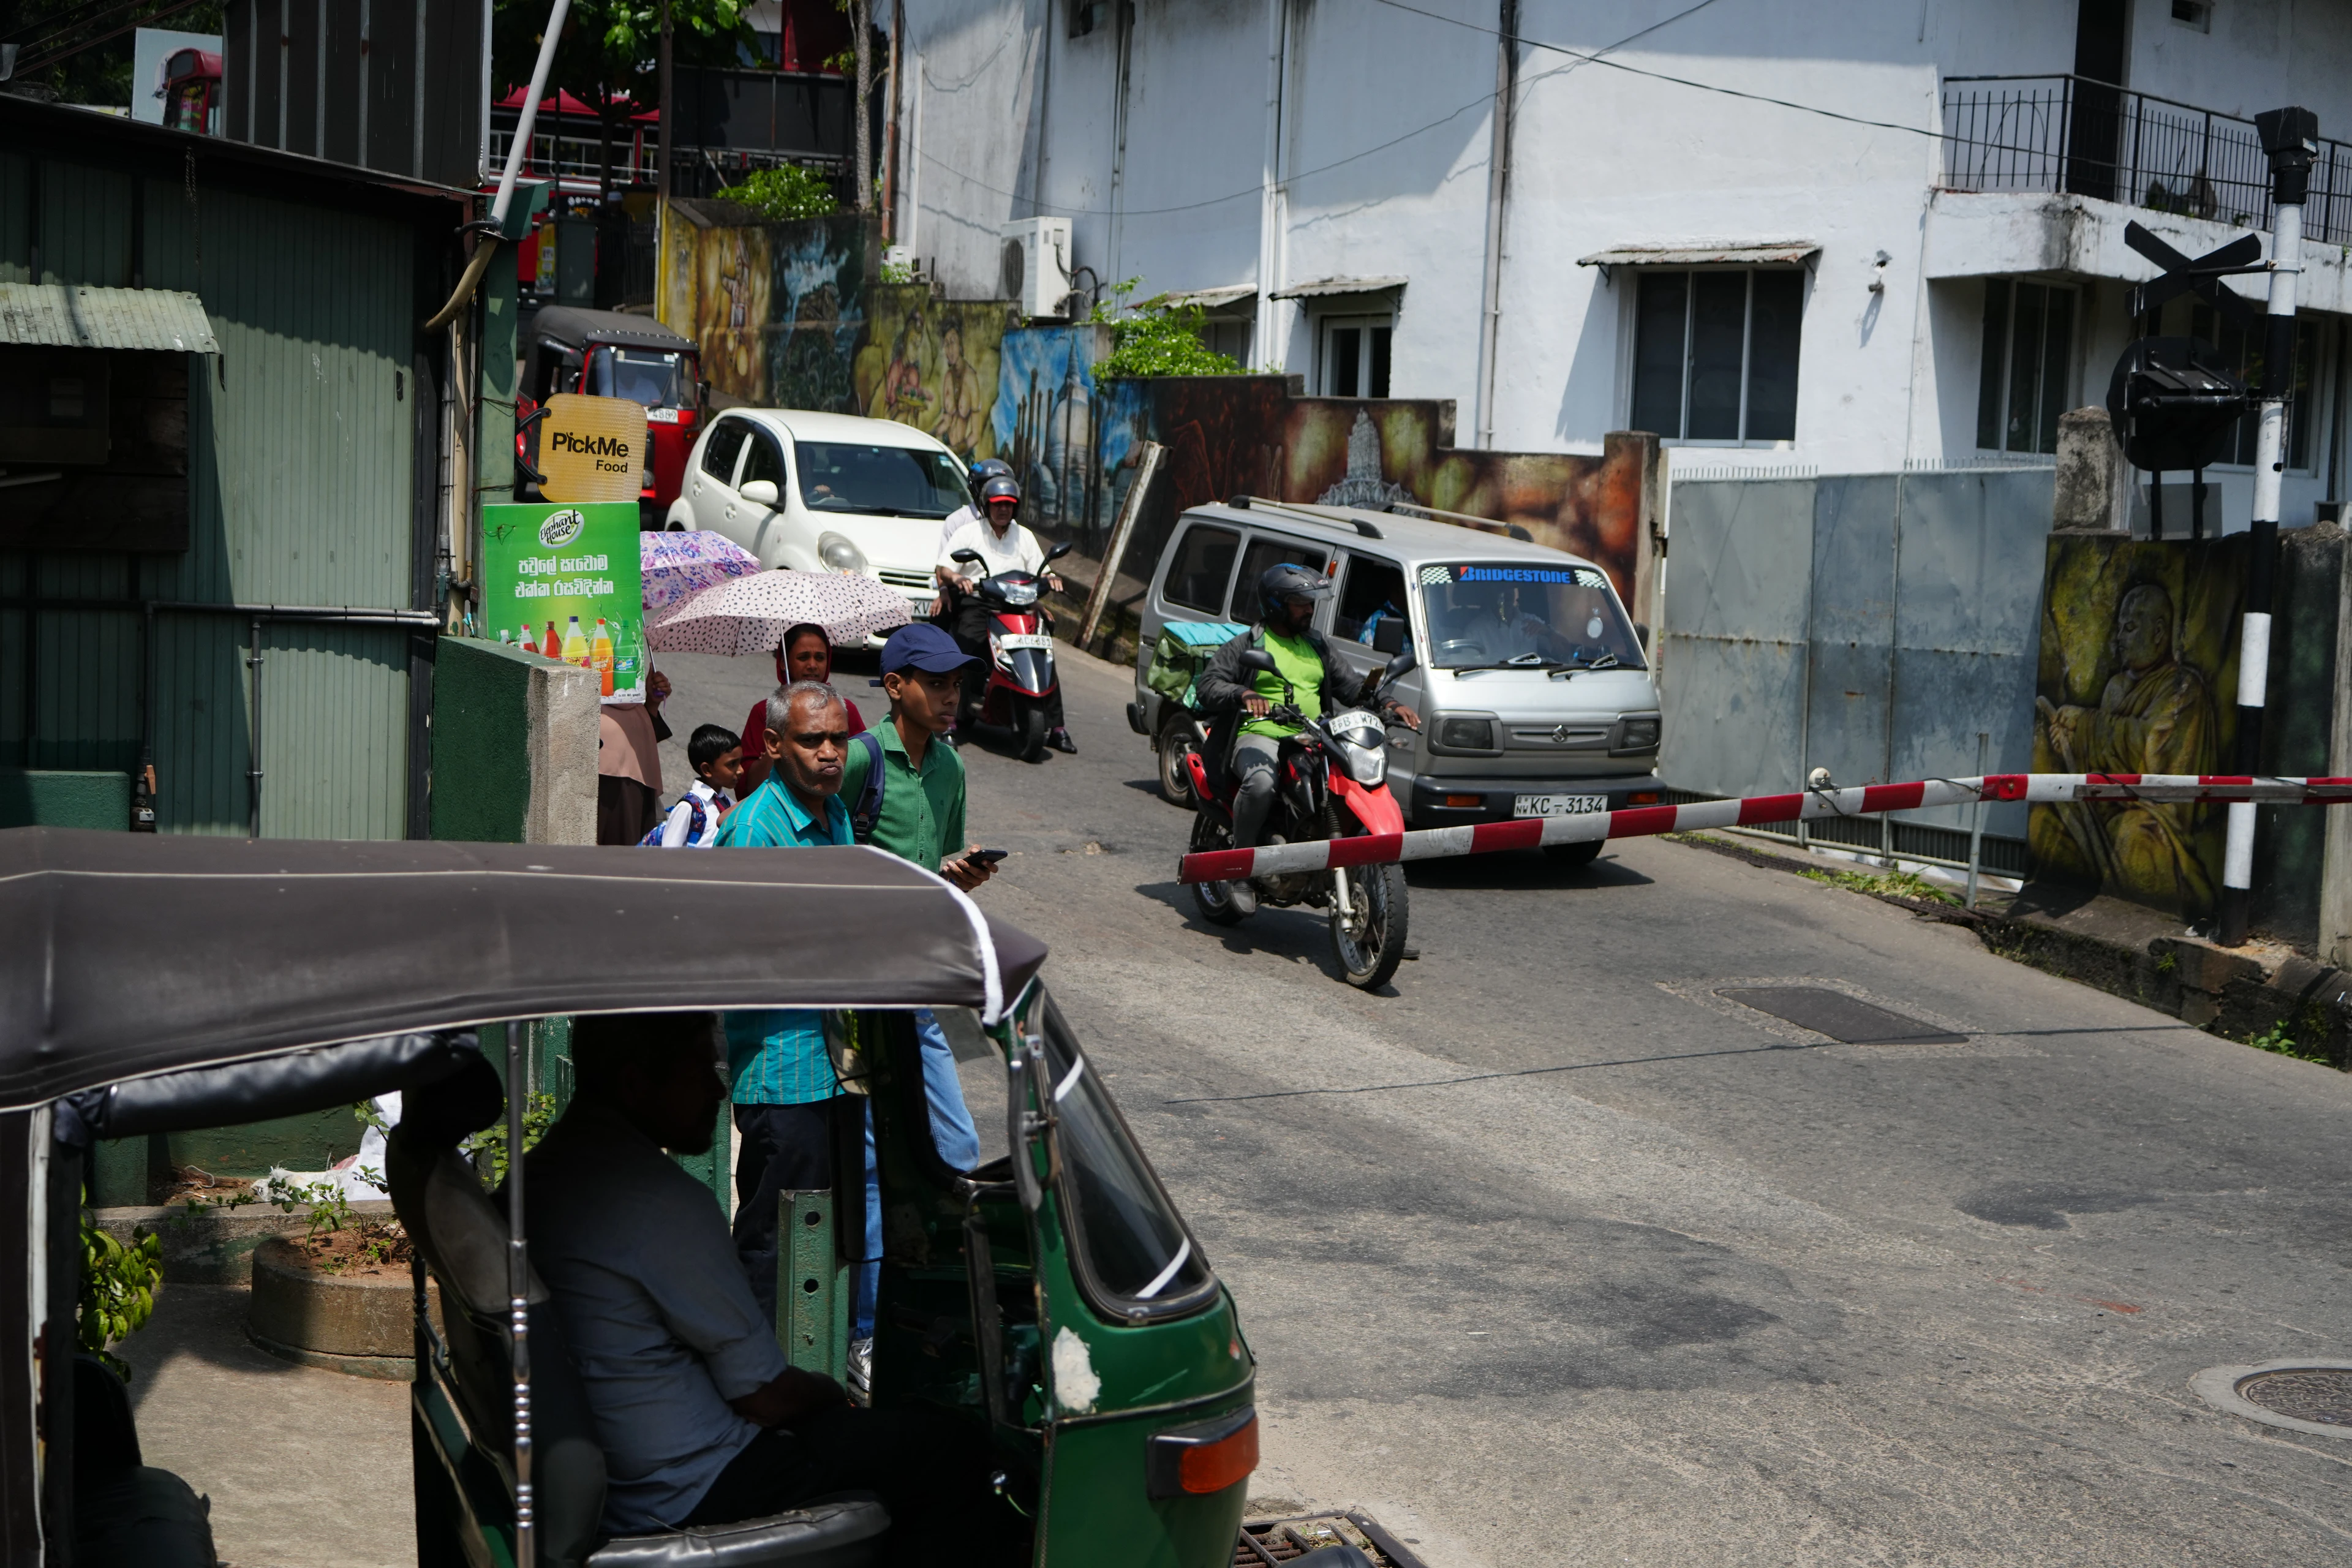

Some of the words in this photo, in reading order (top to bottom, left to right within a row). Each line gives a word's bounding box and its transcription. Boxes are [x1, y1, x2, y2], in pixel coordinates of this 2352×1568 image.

[552, 432, 629, 458] PickMe
[596, 459, 628, 473] Food
[540, 509, 580, 540] Elephant
[546, 525, 571, 545] House
[518, 556, 557, 576] පවුලේ
[1460, 566, 1571, 584] BRIDGESTONE
[515, 579, 550, 598] එක්ක
[1516, 805, 1529, 814] NW
